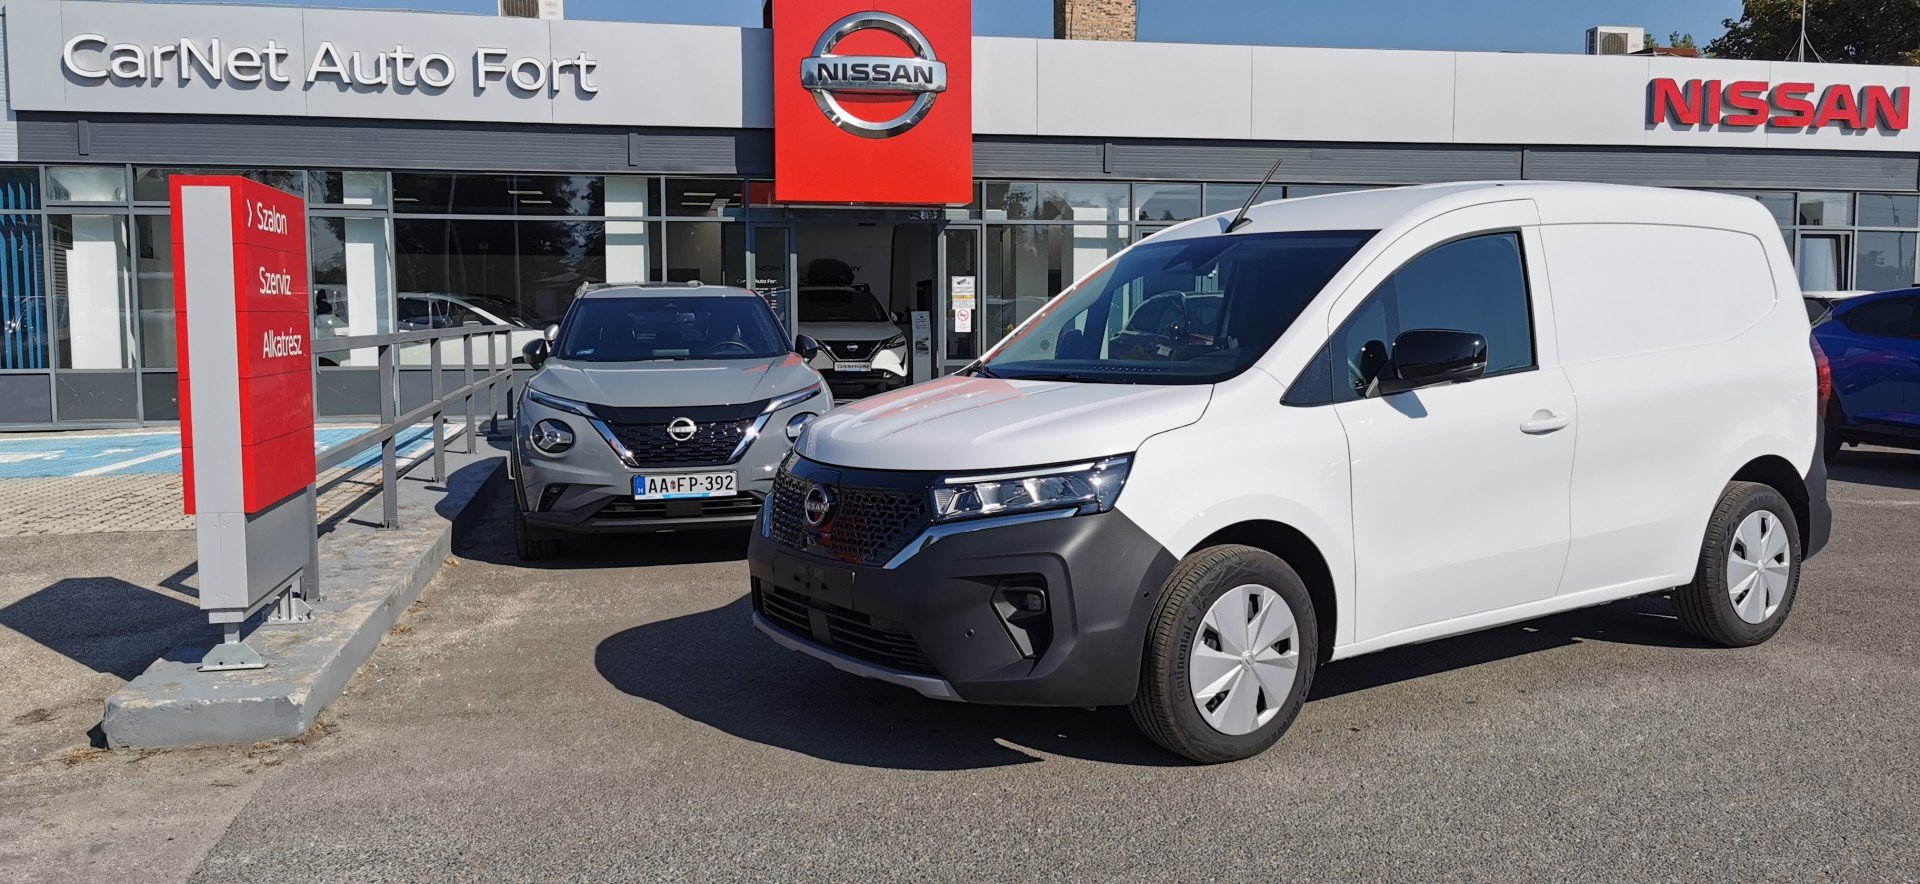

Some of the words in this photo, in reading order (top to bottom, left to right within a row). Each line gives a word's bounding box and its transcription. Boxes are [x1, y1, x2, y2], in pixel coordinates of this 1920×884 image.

[61, 33, 291, 84] CarNet
[305, 41, 457, 88] Auto
[475, 46, 598, 94] Fort
[816, 62, 924, 84] NISSAN
[1649, 77, 1911, 131] NISSAN
[256, 201, 288, 236] Szalon
[258, 266, 292, 296] Szerviz
[262, 326, 303, 359] Alkatrész
[648, 478, 669, 493] AA
[677, 475, 733, 492] FP-392
[1175, 624, 1192, 702] Continental
